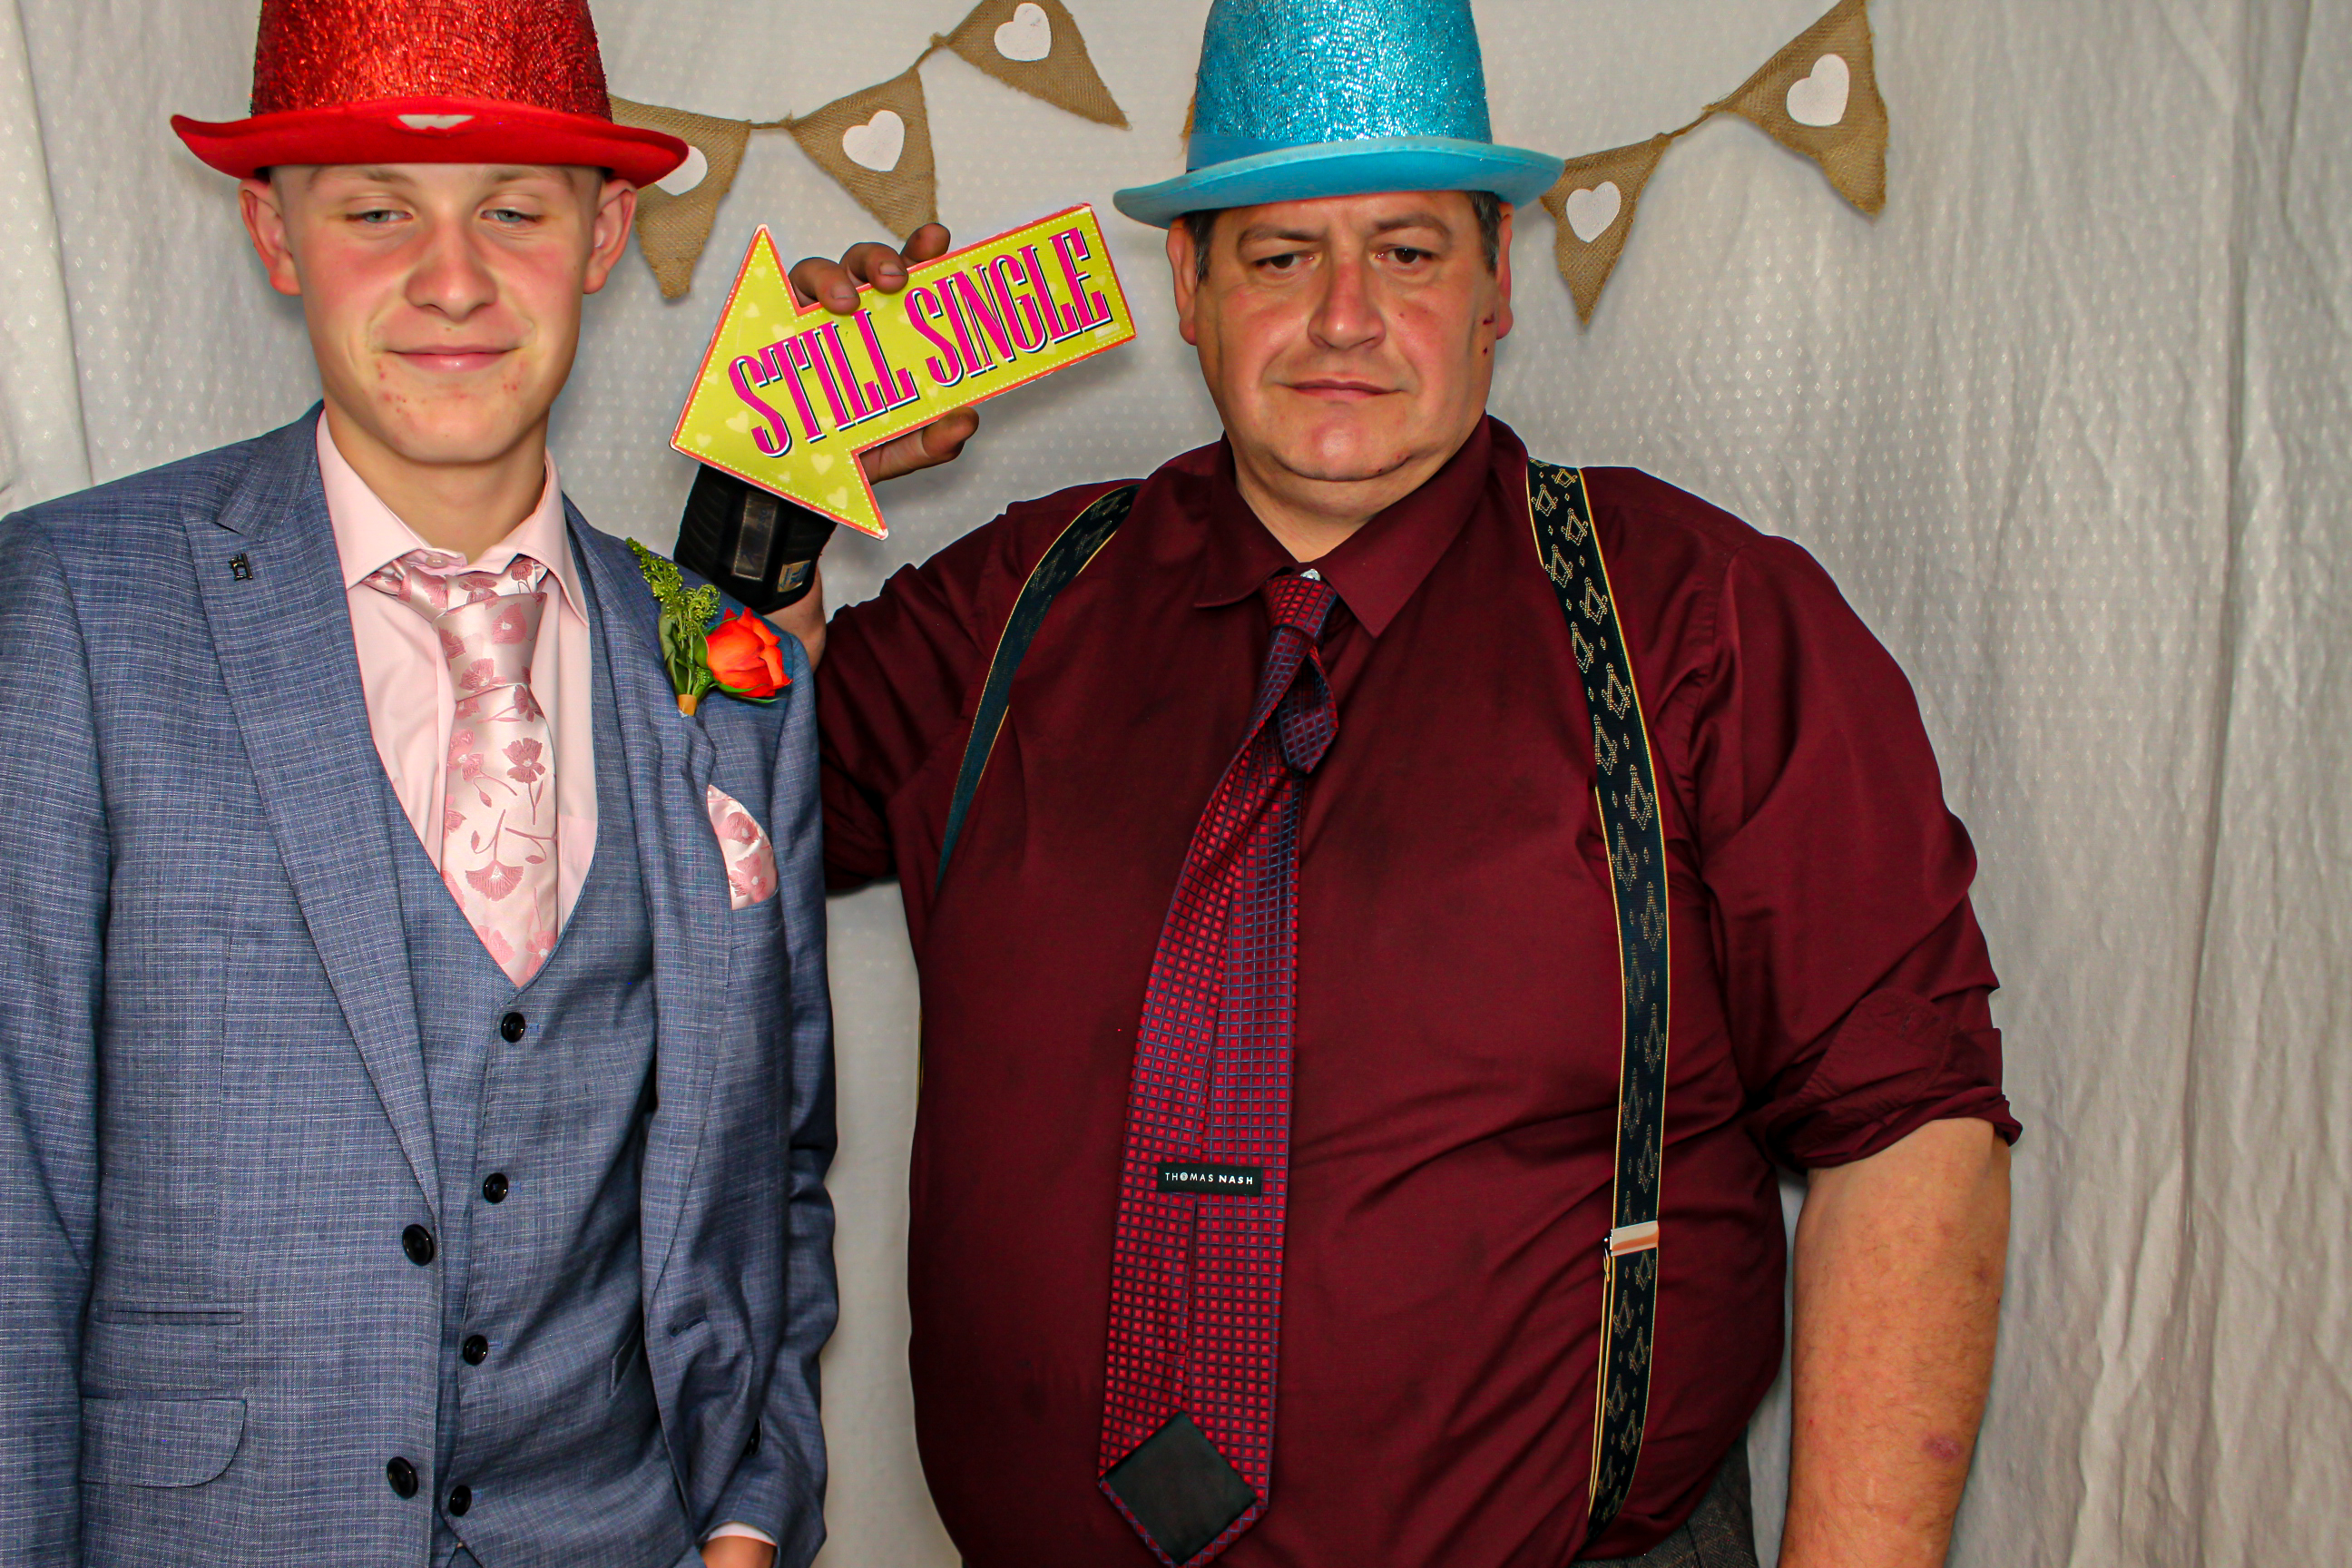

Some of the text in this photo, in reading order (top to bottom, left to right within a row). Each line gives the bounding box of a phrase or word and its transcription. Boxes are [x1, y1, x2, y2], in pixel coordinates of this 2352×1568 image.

[728, 227, 1112, 457] STILL SINGLE
[1165, 1171, 1253, 1185] THOMAS NASH
